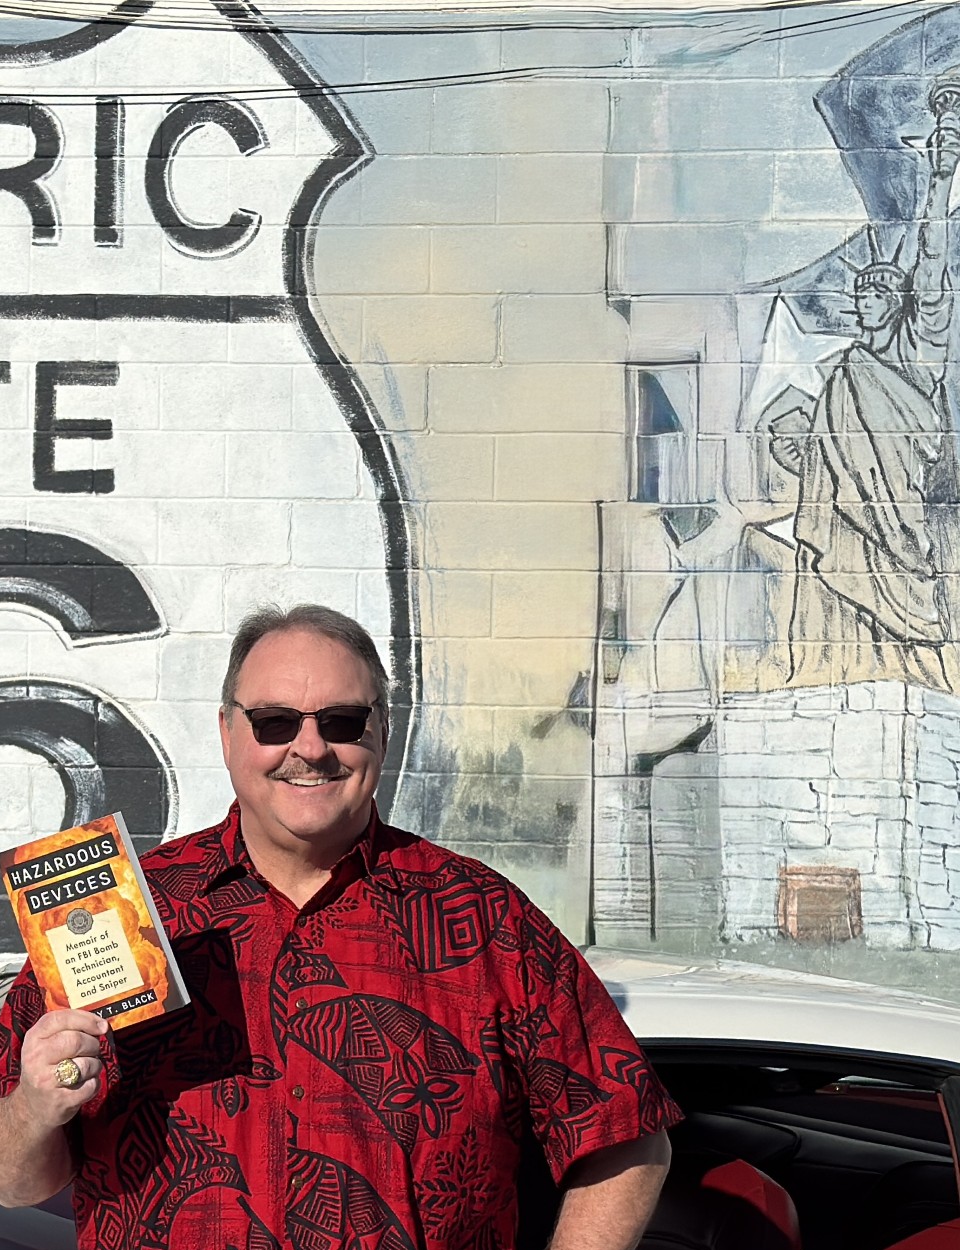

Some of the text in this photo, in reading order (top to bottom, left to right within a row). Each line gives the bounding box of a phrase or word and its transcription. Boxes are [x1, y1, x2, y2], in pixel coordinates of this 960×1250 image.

[10, 839, 113, 886] HAZARDOUS
[29, 871, 112, 910] DEVICES
[65, 929, 109, 952] Memoir of
[65, 940, 119, 965] an FBI Bomb
[71, 955, 120, 975] Technician,
[76, 964, 125, 987] Accountant
[80, 976, 128, 998] and Sniper
[106, 1006, 118, 1015] T.
[121, 991, 155, 1010] BLACK
